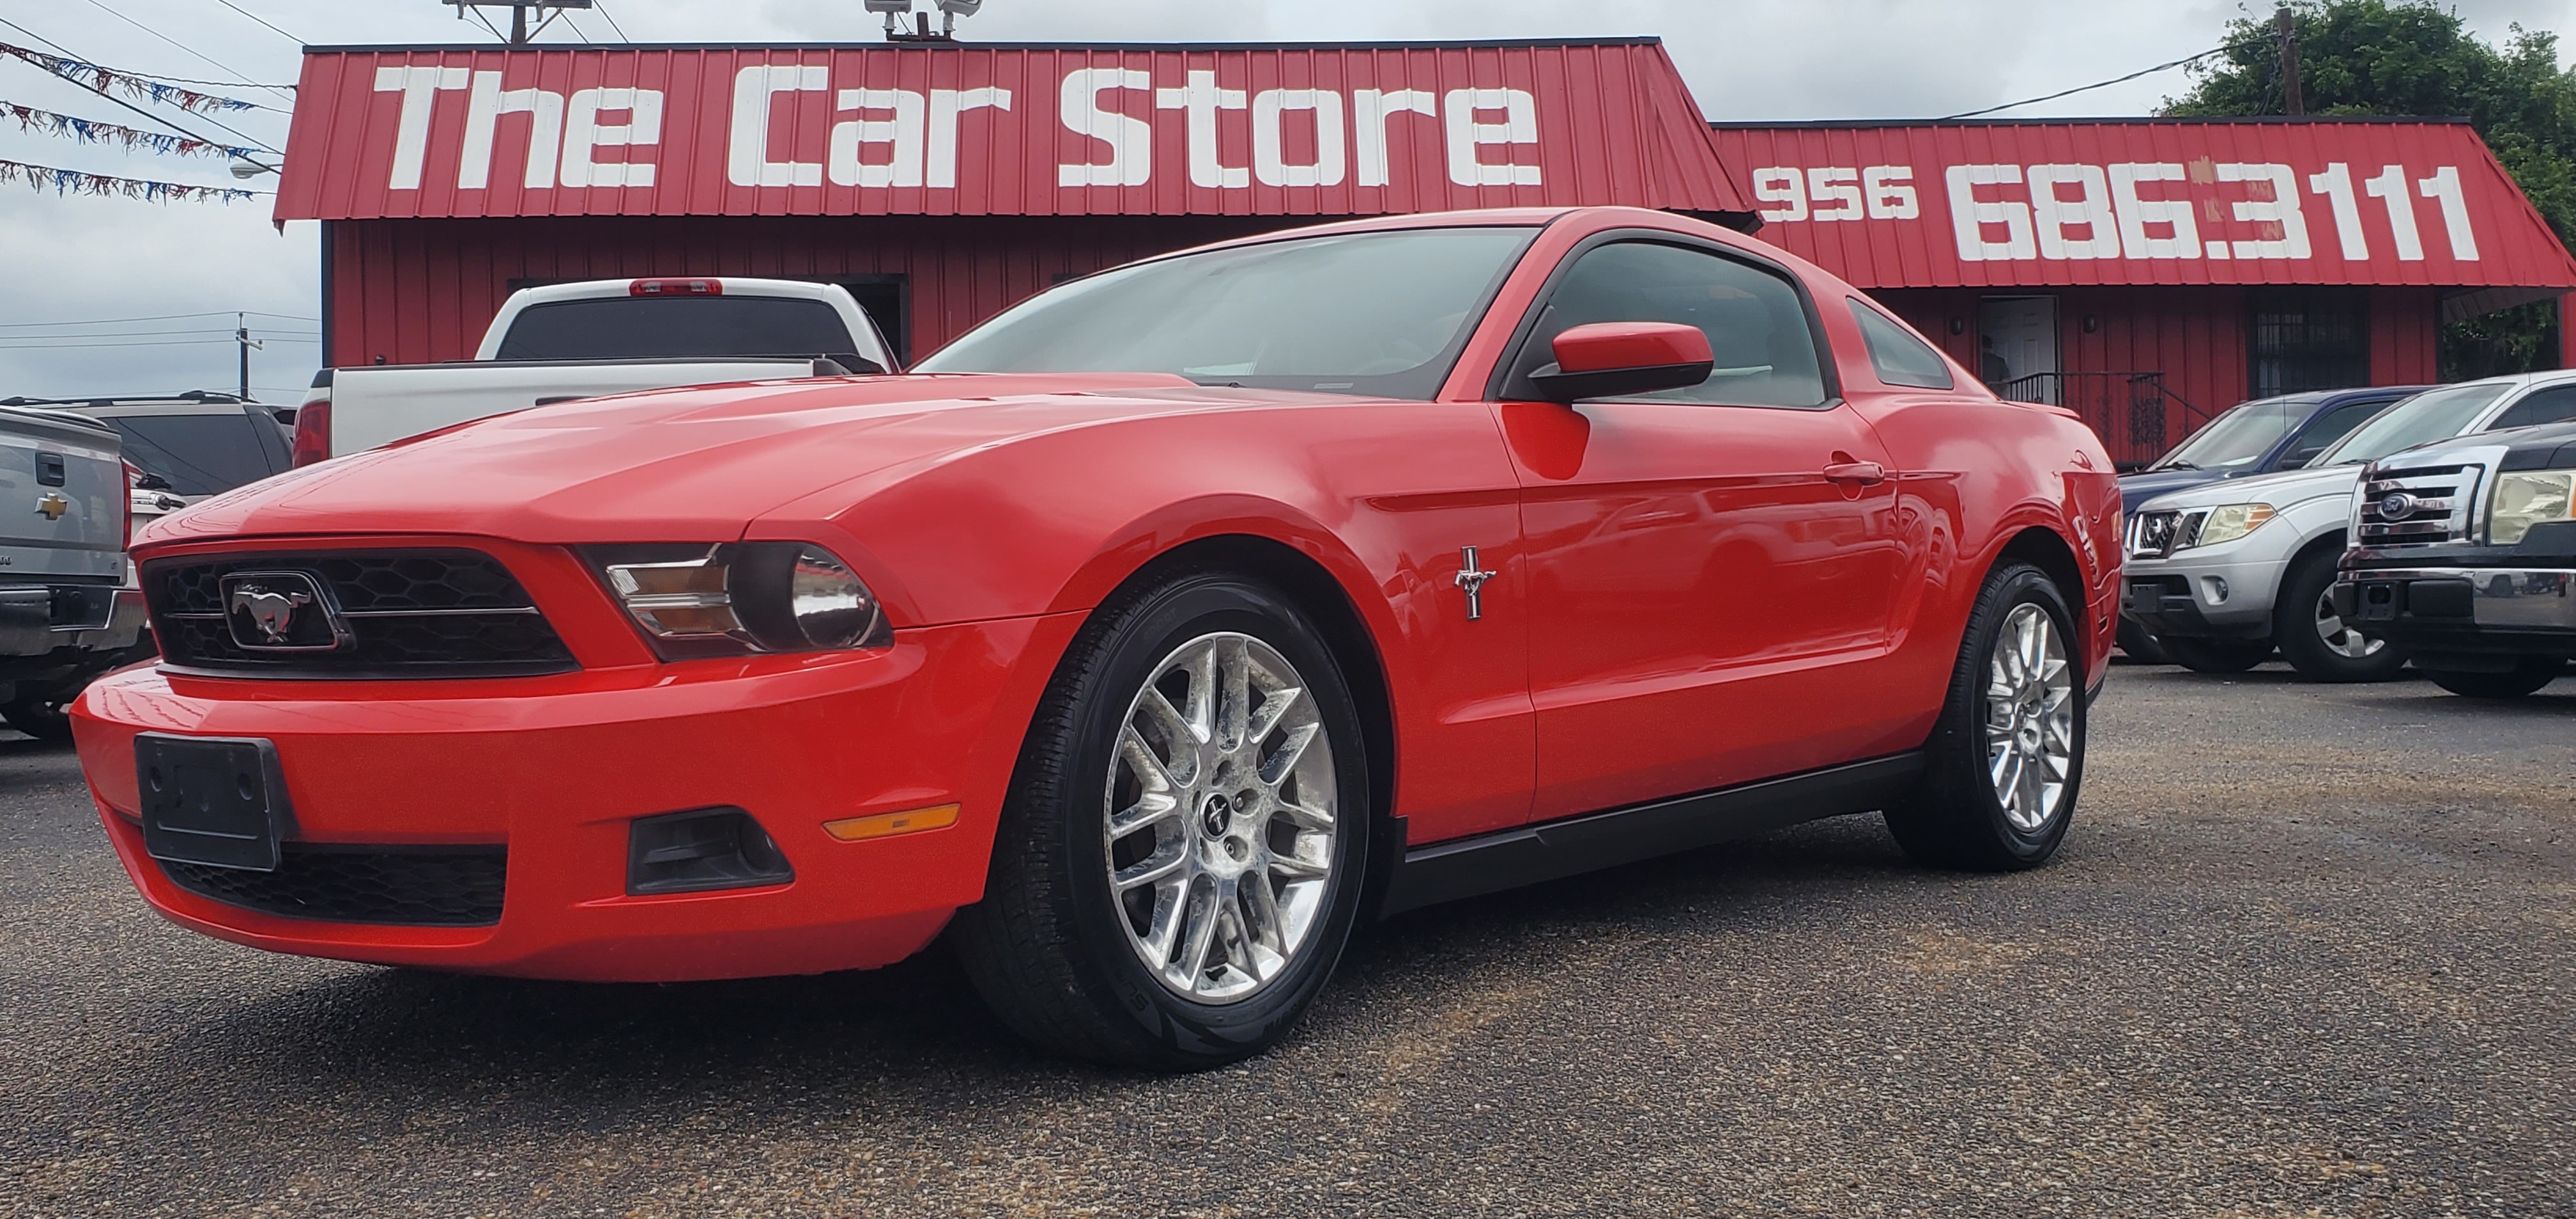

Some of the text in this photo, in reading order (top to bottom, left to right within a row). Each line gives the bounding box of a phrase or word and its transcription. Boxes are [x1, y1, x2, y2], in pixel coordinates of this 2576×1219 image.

[374, 65, 1542, 190] The Car Store
[1752, 162, 2480, 261] 956 686.3111
